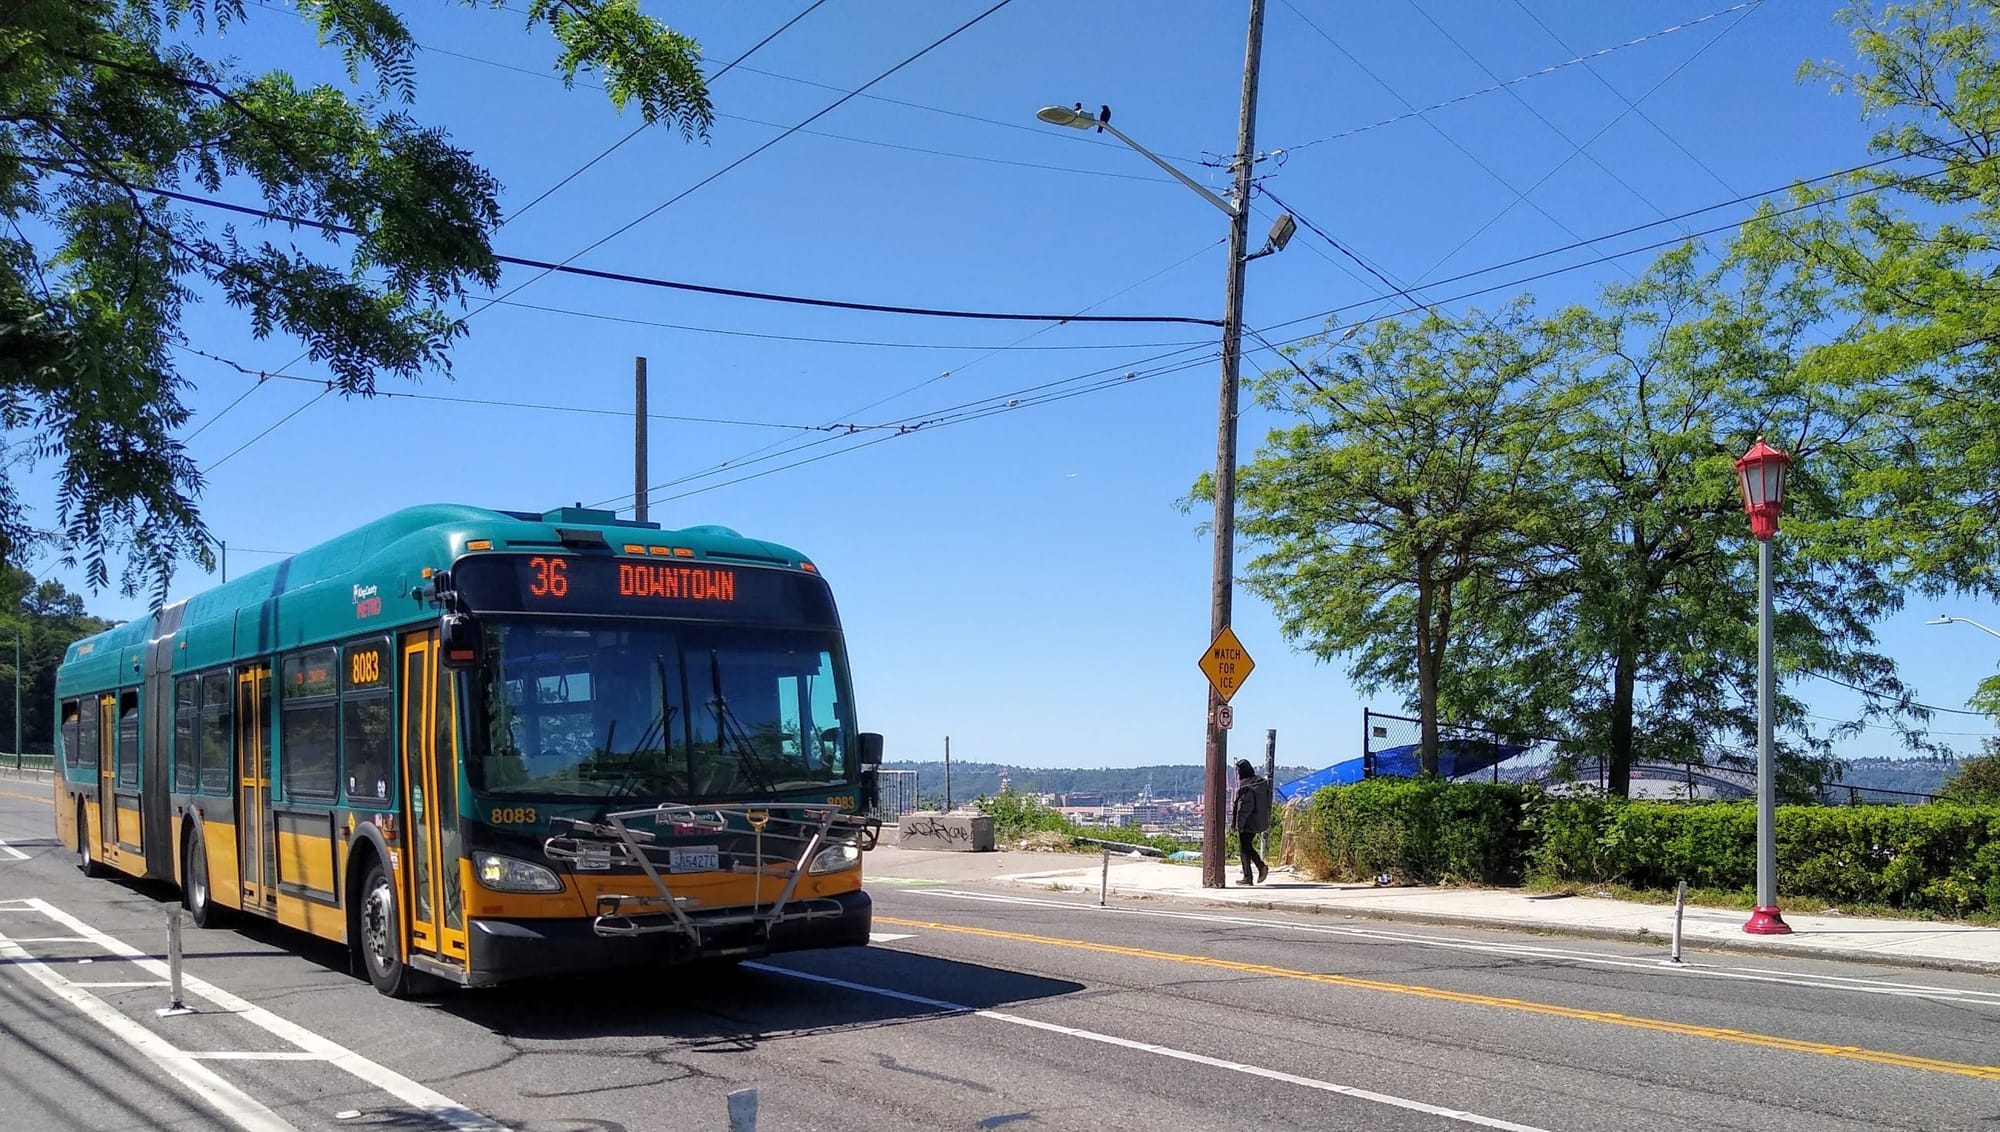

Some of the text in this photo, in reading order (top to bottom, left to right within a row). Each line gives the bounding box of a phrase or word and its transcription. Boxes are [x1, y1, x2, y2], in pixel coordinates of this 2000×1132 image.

[529, 557, 734, 600] 36 DOWNTOWN
[1214, 649, 1241, 660] WATCH
[353, 651, 379, 683] 8083
[1219, 663, 1235, 673] FOR
[1220, 677, 1233, 688] ICE
[491, 808, 537, 824] 8083
